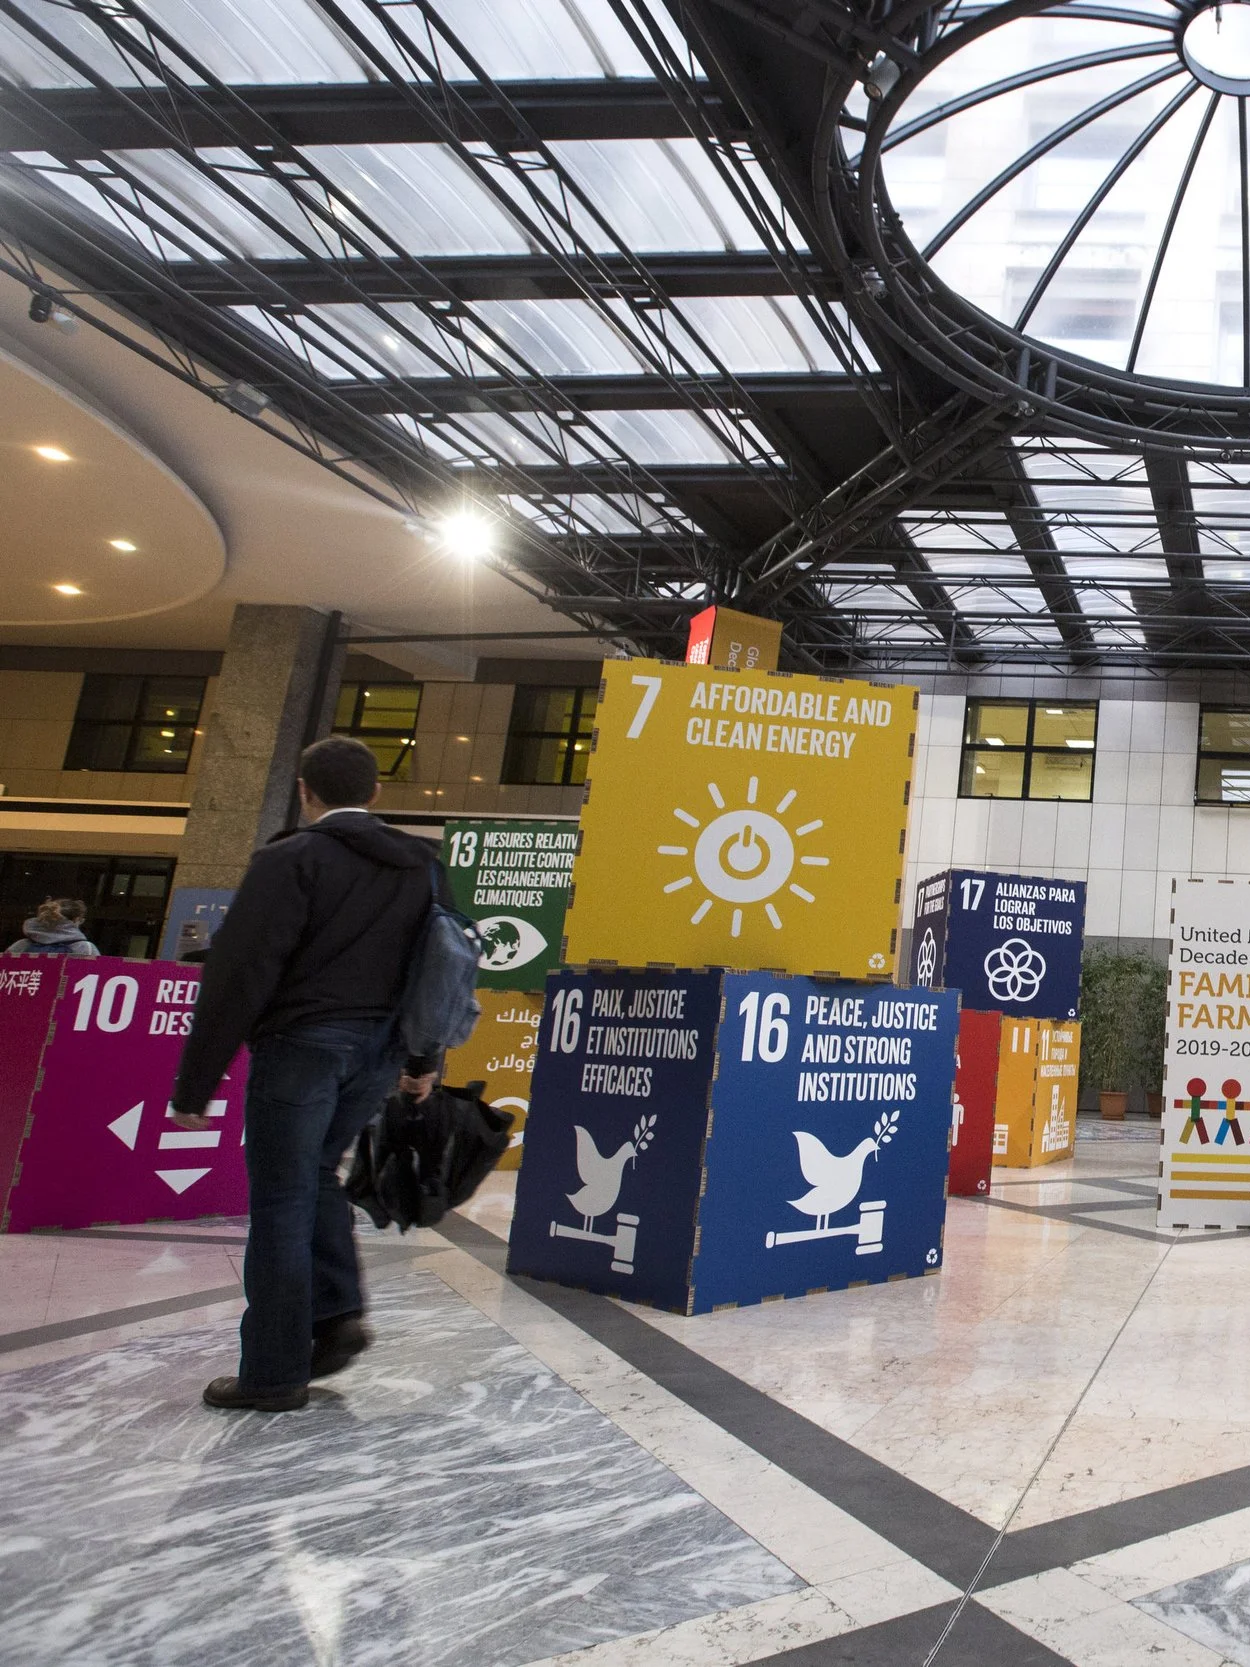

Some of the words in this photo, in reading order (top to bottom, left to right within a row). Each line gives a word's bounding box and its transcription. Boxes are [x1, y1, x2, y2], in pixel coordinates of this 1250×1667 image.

[626, 674, 662, 739] 7
[690, 681, 841, 722] AFFORDABLE
[843, 697, 892, 727] AND
[686, 716, 763, 751] CLEAN
[766, 724, 857, 759] ENERGY
[450, 831, 478, 868] 13
[483, 832, 534, 849] MESURES
[480, 848, 490, 867] À
[490, 851, 504, 867] LA
[504, 851, 536, 868] LUTTE
[476, 870, 497, 886] LES
[996, 882, 1046, 900] ALIANZAS
[1048, 887, 1076, 904] PARA
[474, 888, 544, 908] CLIMATIQUES
[960, 878, 986, 911] 17
[994, 898, 1036, 916] LOGRAR
[993, 915, 1014, 930] LOS
[1016, 916, 1072, 935] OBJETIVOS
[1180, 926, 1242, 944] United
[1180, 948, 1248, 965] Decade
[72, 973, 139, 1033] 10
[591, 989, 625, 1020] PAIX,
[628, 990, 687, 1020] JUSTICE
[805, 996, 868, 1030] PEACE,
[871, 1000, 939, 1031] JUSTICE
[550, 988, 584, 1054] 16
[738, 991, 790, 1063] 16
[586, 1026, 604, 1054] ET
[604, 1027, 699, 1060] INSTITUTIONS
[801, 1034, 842, 1064] AND
[844, 1036, 912, 1065] STRONG
[1042, 1029, 1050, 1060] 11
[581, 1063, 653, 1098] EFFICACES
[797, 1072, 917, 1102] INSTITUTIONS
